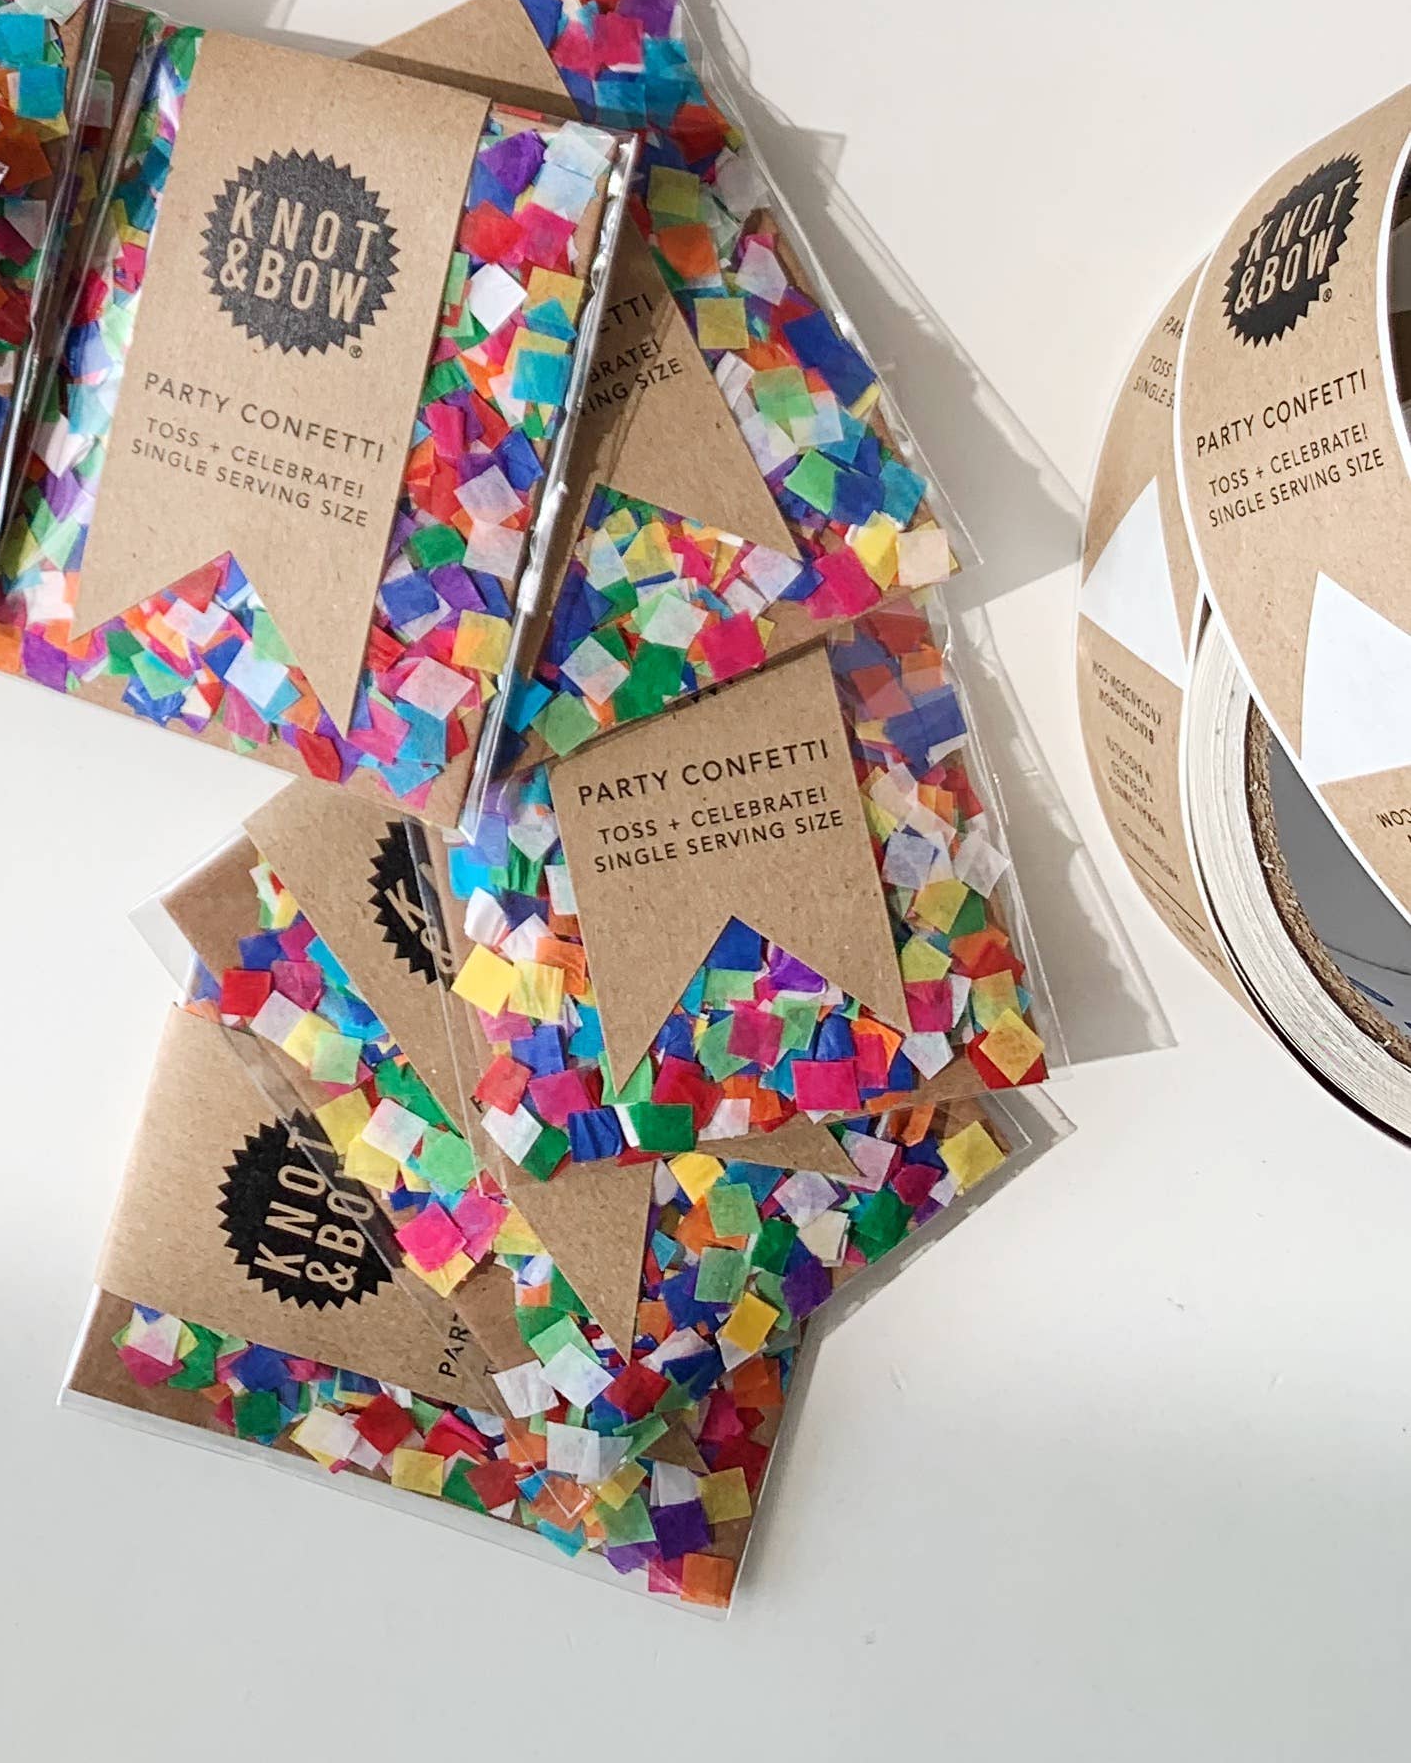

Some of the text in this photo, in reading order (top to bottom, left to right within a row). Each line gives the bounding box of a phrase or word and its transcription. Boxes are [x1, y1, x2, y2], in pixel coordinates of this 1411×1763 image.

[229, 186, 380, 271] KNOT
[1244, 176, 1352, 266] KNOT
[219, 237, 368, 324] &BOW
[1234, 223, 1337, 317] &BOW
[144, 371, 385, 463] PARTY CONFETTI
[635, 358, 683, 390] SIZE
[1195, 368, 1368, 458] PARTY CONFETTI
[131, 438, 369, 528] SINGLE SERVING SIZE
[146, 417, 199, 447] TOSS
[231, 445, 364, 500] CELEBRATE!
[1208, 467, 1248, 497] TOSS
[1270, 422, 1369, 475] CELEBRATE!
[1208, 447, 1386, 528] SINGLE SERVING SIZE
[578, 738, 829, 806] PARTY CONFETTI
[593, 810, 844, 873] SINGLE SERVING SIZE
[598, 786, 828, 845] TOSS + CELEBRATE!
[254, 1125, 337, 1279] KNOT
[305, 1165, 375, 1292] &BO
